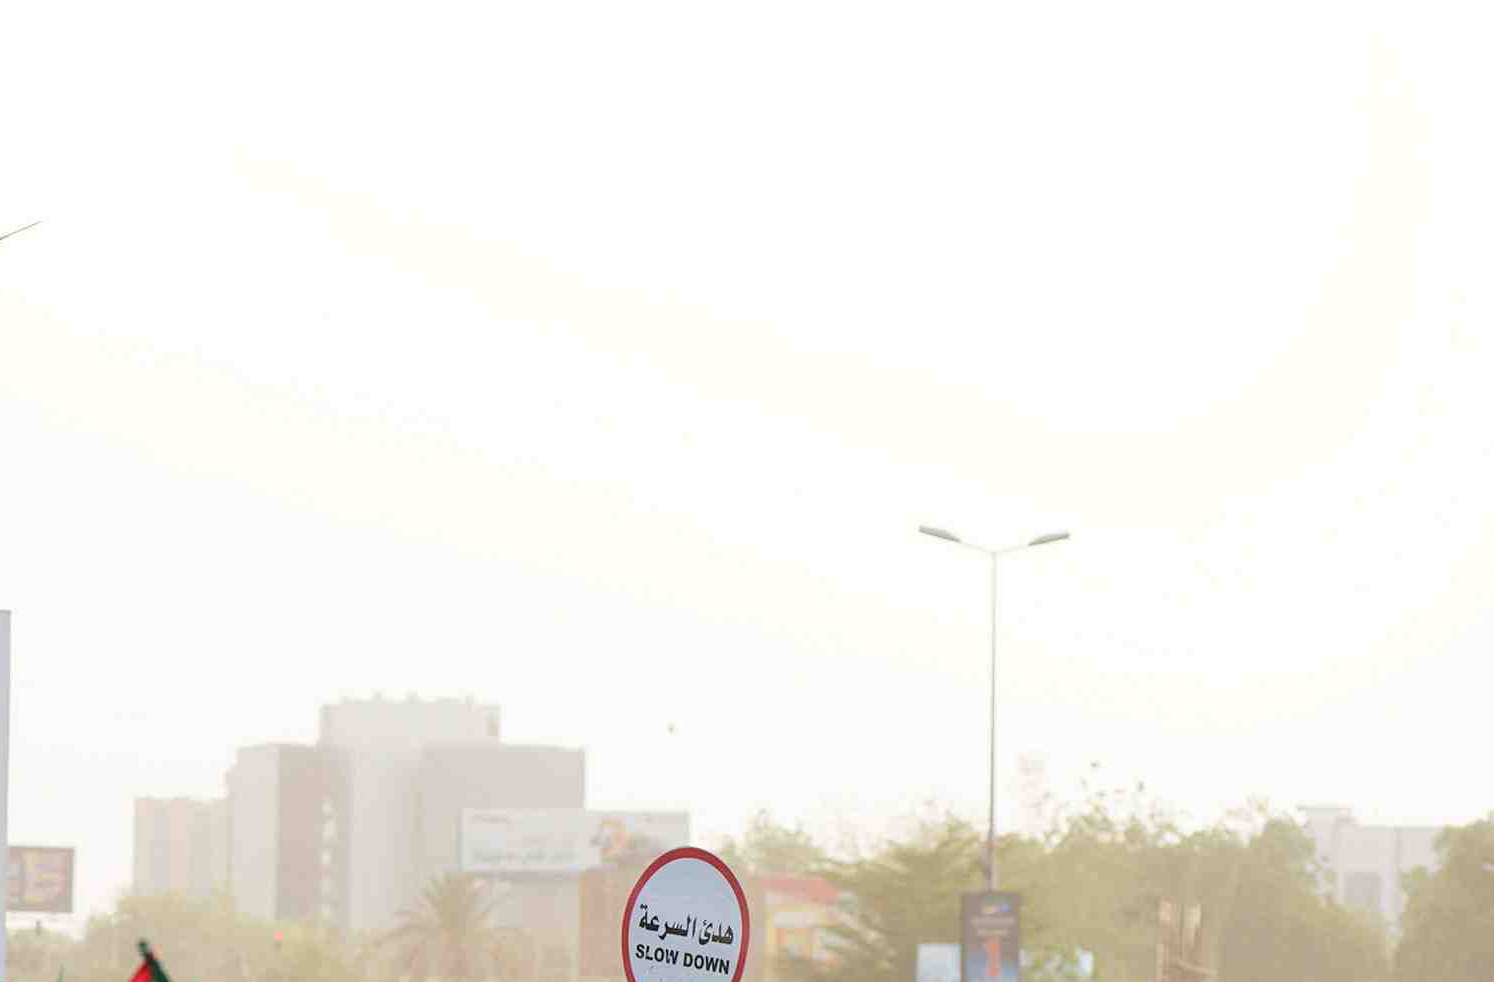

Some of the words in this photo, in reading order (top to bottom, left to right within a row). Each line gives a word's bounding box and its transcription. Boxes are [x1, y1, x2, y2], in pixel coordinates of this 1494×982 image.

[639, 903, 697, 940] السرعة
[635, 943, 679, 965] SLOW
[682, 952, 731, 975] DOWN
